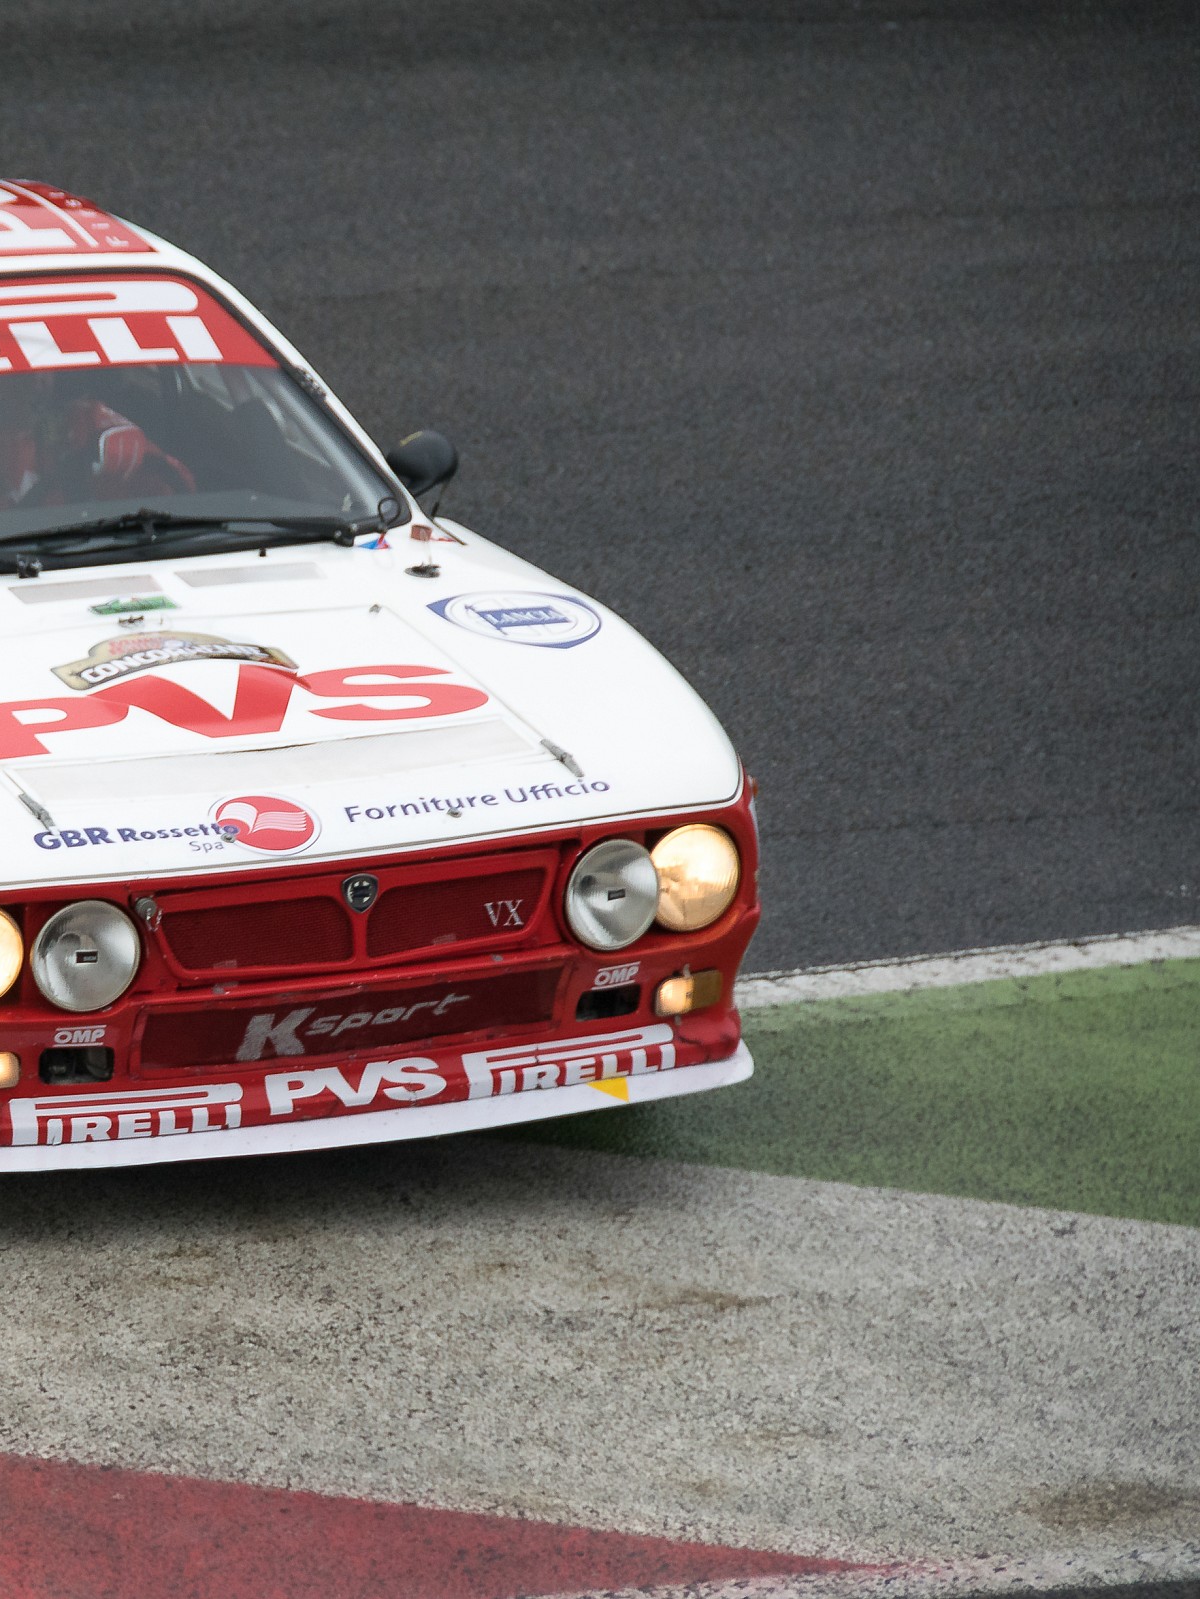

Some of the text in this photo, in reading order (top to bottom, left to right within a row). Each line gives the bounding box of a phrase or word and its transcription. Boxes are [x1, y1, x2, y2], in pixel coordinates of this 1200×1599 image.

[486, 605, 568, 628] LANCIA
[344, 775, 611, 825] Forniture Ufficio
[33, 820, 239, 850] GBR Rossetto
[189, 837, 225, 854] Spa
[485, 899, 525, 927] VX
[593, 965, 640, 987] OMP
[53, 1028, 106, 1045] OMP
[461, 1023, 676, 1100] PIRELLI
[264, 1057, 448, 1116] PVS
[9, 1083, 244, 1146] PIRELLI
